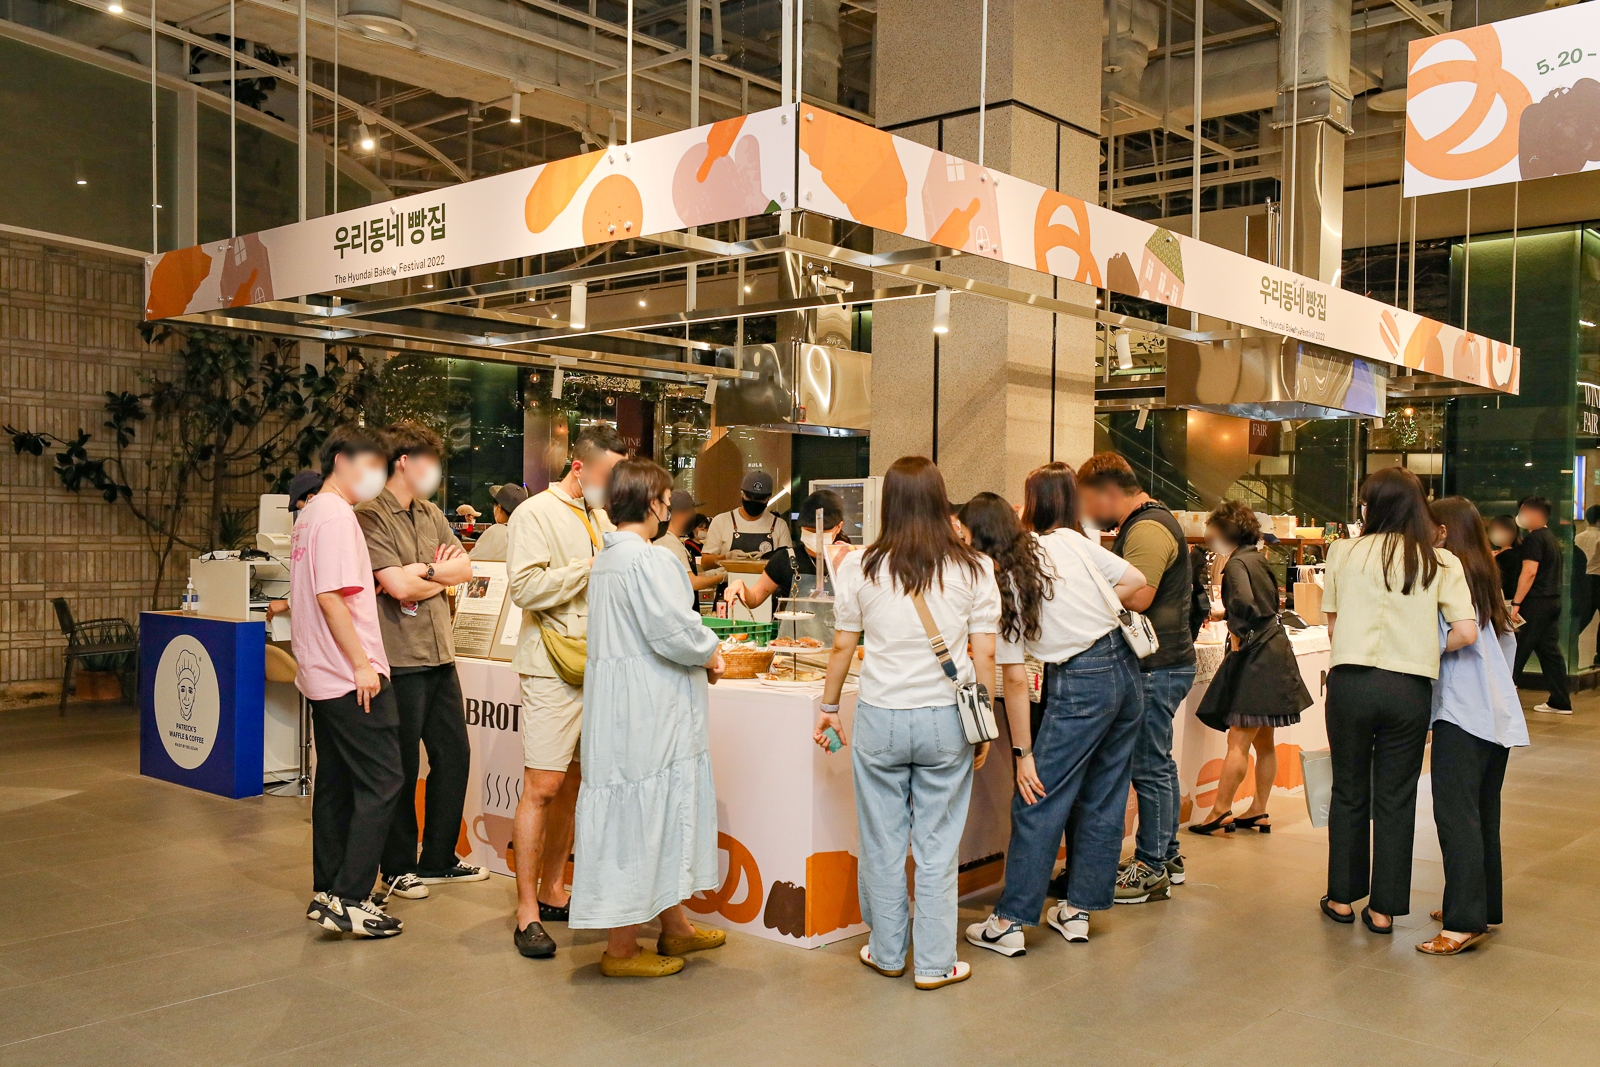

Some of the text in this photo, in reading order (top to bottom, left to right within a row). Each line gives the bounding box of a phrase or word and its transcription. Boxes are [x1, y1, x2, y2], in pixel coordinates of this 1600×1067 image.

[334, 202, 446, 259] 우리동네 빵집
[334, 274, 347, 285] The
[347, 268, 373, 284] Hyundai
[398, 258, 426, 274] Festival
[426, 254, 445, 269] 2022
[1260, 276, 1326, 322] 우리동네 빵집
[1252, 423, 1268, 437] FAIR
[1583, 411, 1599, 435] FAIR
[168, 730, 184, 740] WAFFLE
[189, 734, 204, 744] COFFEE
[176, 722, 197, 732] PATRICK'S
